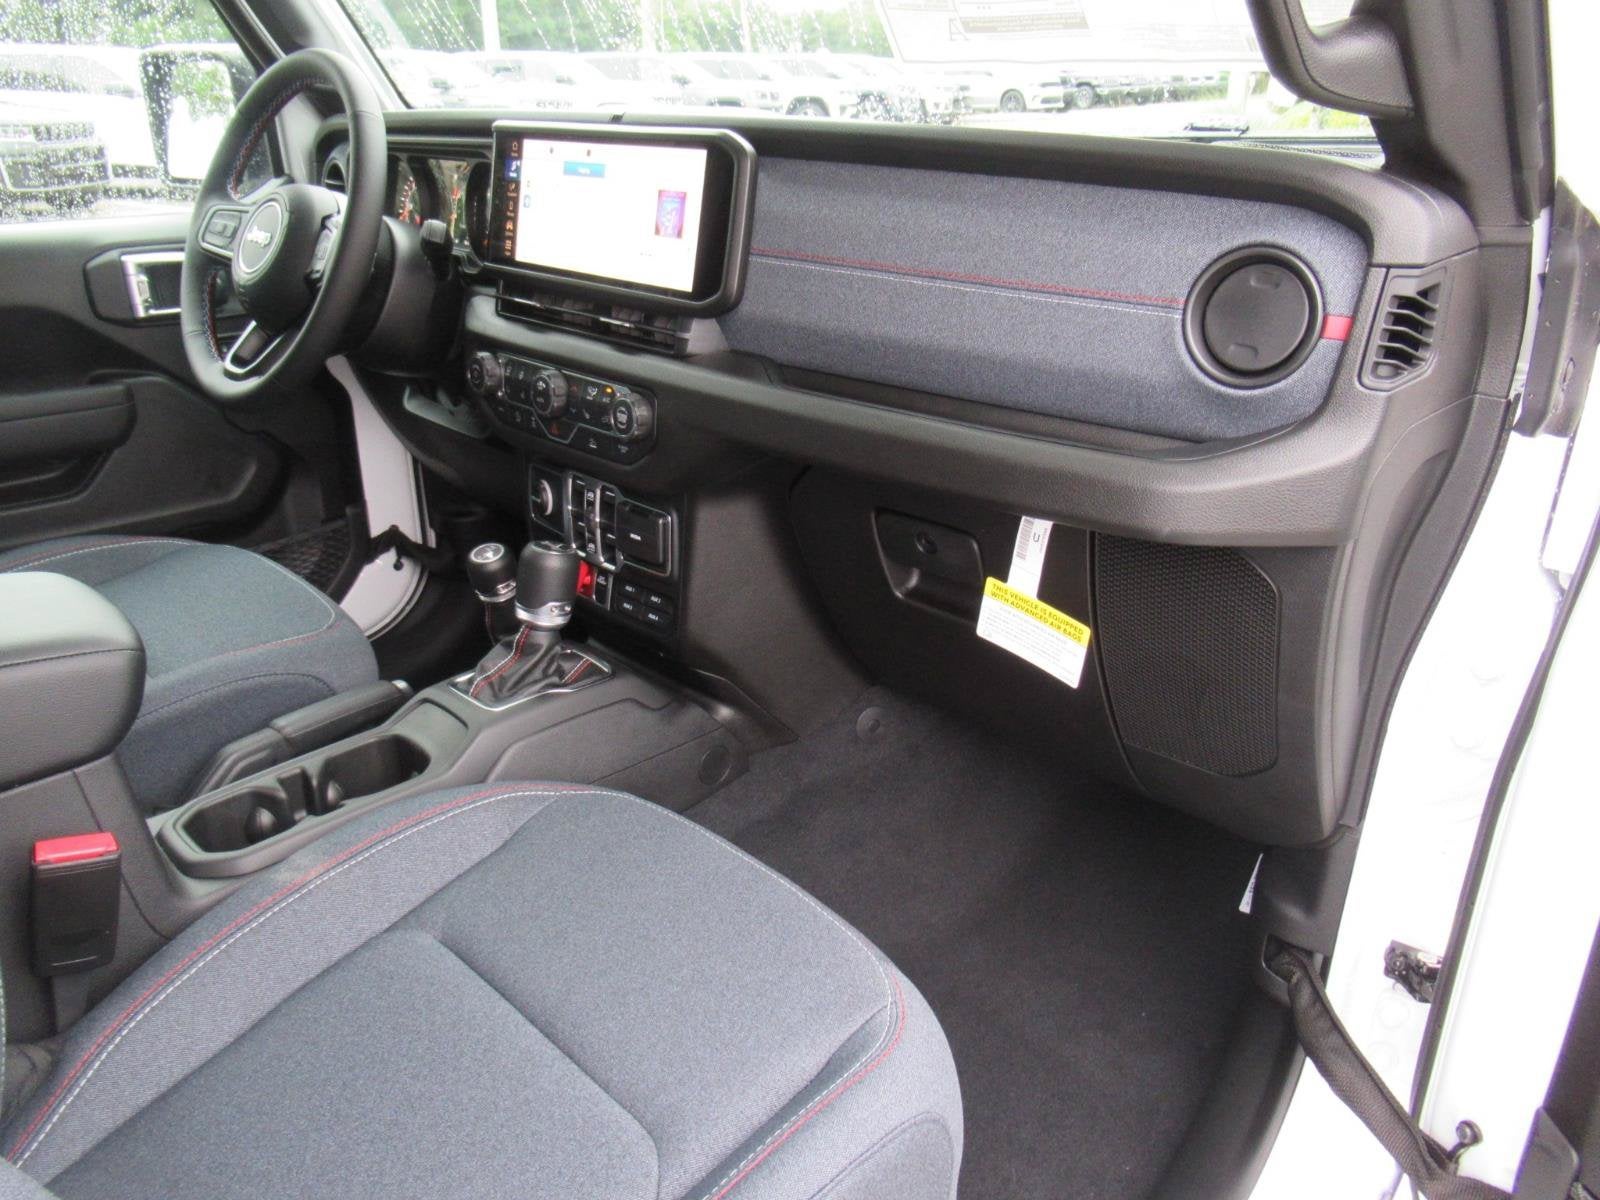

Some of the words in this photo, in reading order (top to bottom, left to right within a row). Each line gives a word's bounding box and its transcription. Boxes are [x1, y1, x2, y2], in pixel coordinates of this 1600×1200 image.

[990, 591, 1009, 604] WITH
[1010, 600, 1049, 624] ADVANCED
[1050, 620, 1062, 631] AIR
[1062, 627, 1083, 643] BAGS
[992, 583, 1009, 596] THIS
[1009, 591, 1040, 611] VEHICLE
[1040, 606, 1048, 616] IS
[1048, 611, 1085, 636] EQUIPPED
